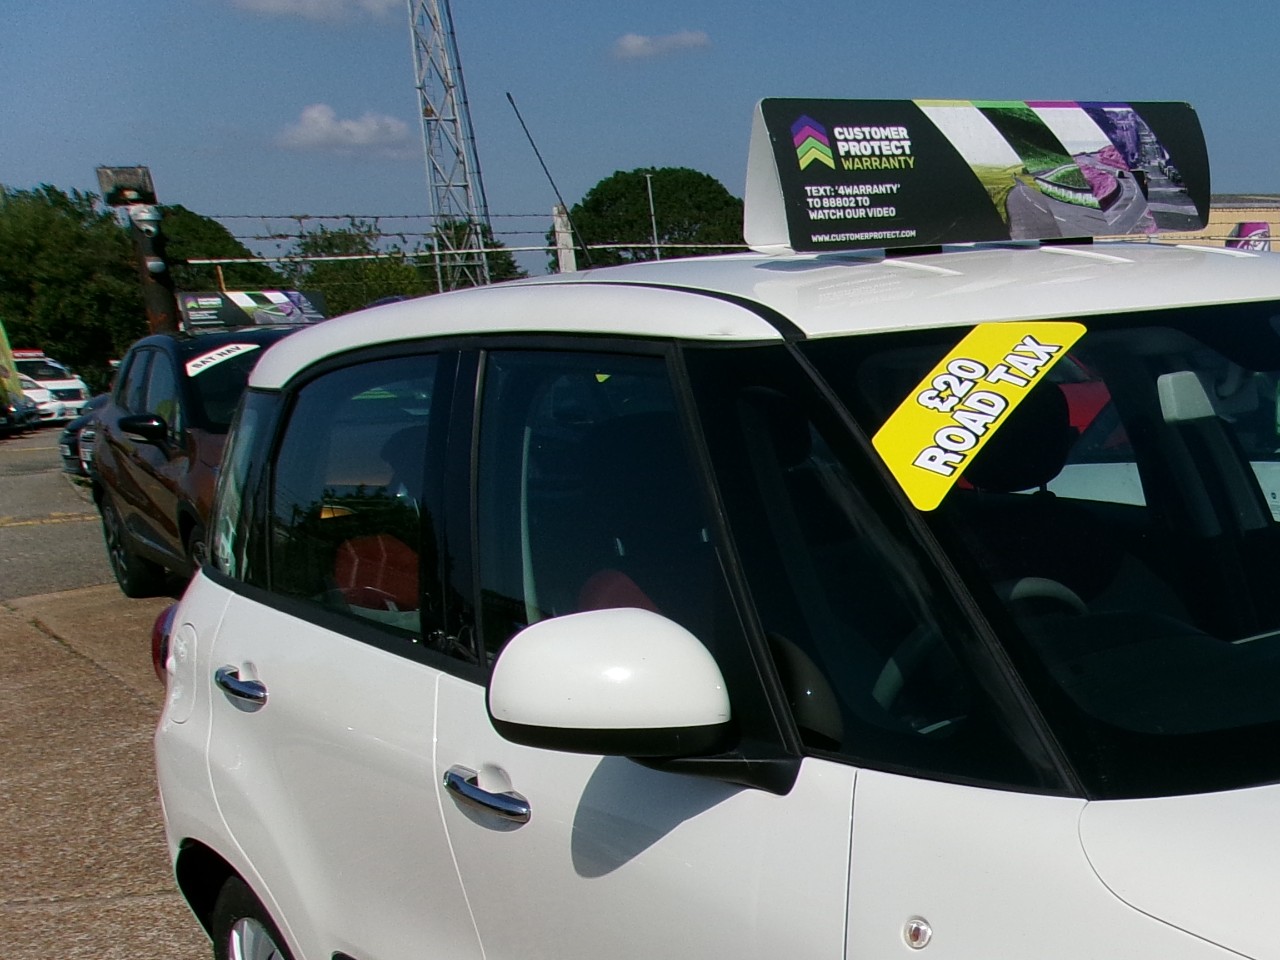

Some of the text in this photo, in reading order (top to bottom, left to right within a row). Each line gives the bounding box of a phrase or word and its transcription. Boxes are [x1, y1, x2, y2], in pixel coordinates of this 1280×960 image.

[833, 126, 910, 140] CUSTOMER
[836, 140, 911, 156] PROTECT
[841, 156, 915, 171] WARRANTY
[804, 185, 835, 197] TEXT:
[806, 196, 870, 208] TO 88802 TO
[808, 206, 896, 220] WATCH OUR VIDEO
[811, 229, 917, 243] WWW.CUSTOMERPROTECT.COM
[191, 355, 217, 369] SAT
[916, 357, 990, 414] £20
[911, 335, 1064, 477] ROAD TAX
